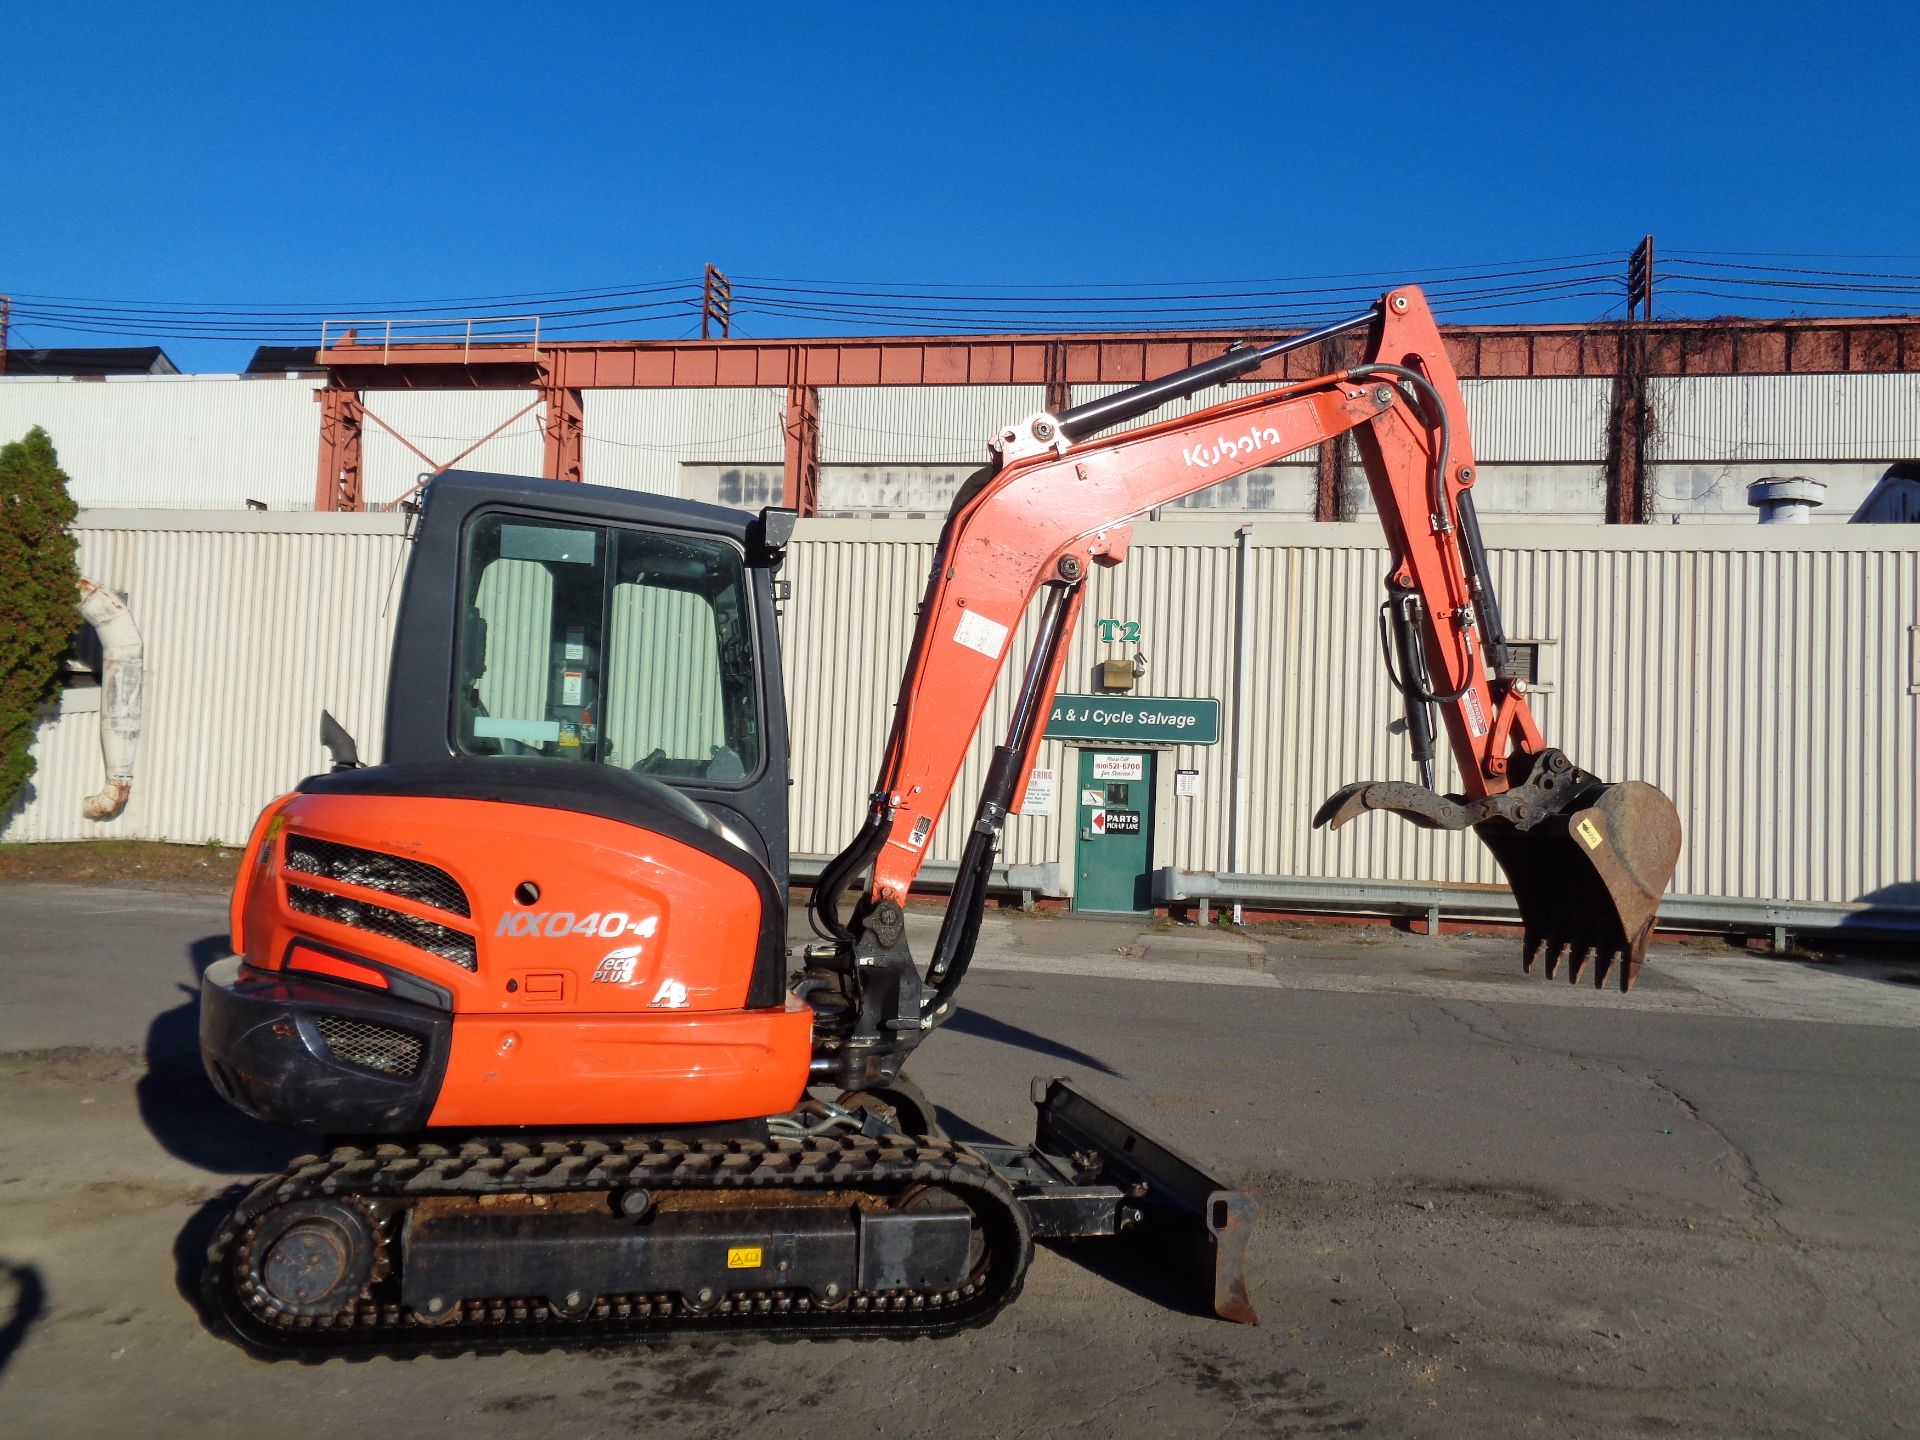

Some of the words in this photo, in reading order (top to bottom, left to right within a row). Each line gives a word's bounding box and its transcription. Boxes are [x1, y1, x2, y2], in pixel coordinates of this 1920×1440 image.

[1182, 426, 1281, 468] Kubota
[1097, 618, 1142, 643] T2
[1051, 708, 1062, 721] A
[1065, 708, 1077, 722] &
[1080, 709, 1089, 722] J
[1092, 709, 1134, 725] Cycle
[1138, 711, 1196, 729] Salvage
[1106, 814, 1139, 823] PARTS
[1106, 822, 1125, 830] PICK-UP
[495, 911, 659, 938] KX040-4
[591, 970, 632, 983] PLUS
